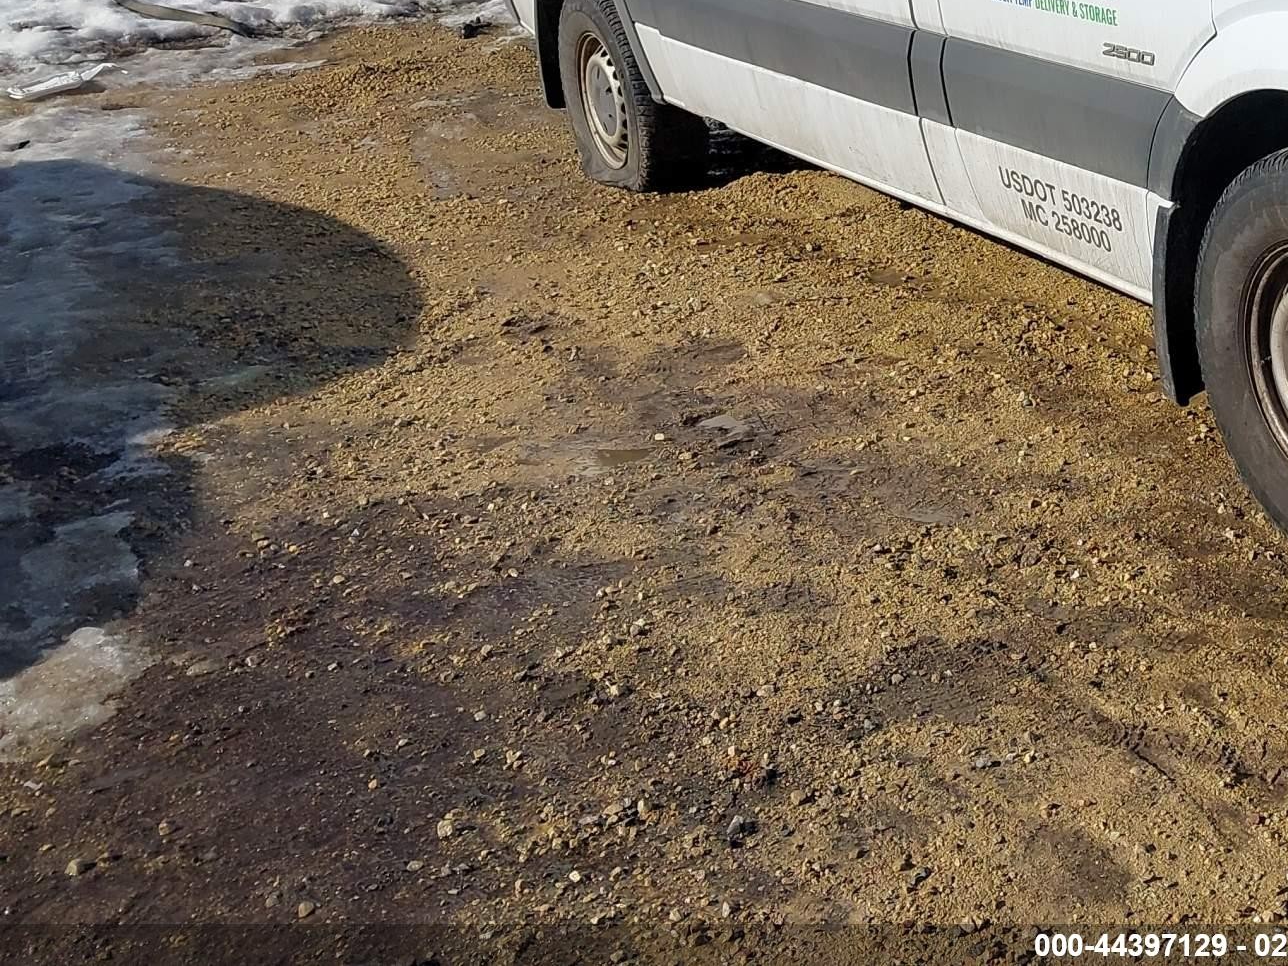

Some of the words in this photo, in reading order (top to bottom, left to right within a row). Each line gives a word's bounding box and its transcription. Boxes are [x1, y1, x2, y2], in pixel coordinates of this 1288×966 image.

[1071, 2, 1079, 18] &
[1079, 3, 1119, 27] STORAGE
[1102, 42, 1155, 66] 2500
[998, 165, 1056, 206] USDOT
[1062, 190, 1123, 232] 503238
[1021, 198, 1049, 227] MC
[1052, 212, 1112, 252] 258000
